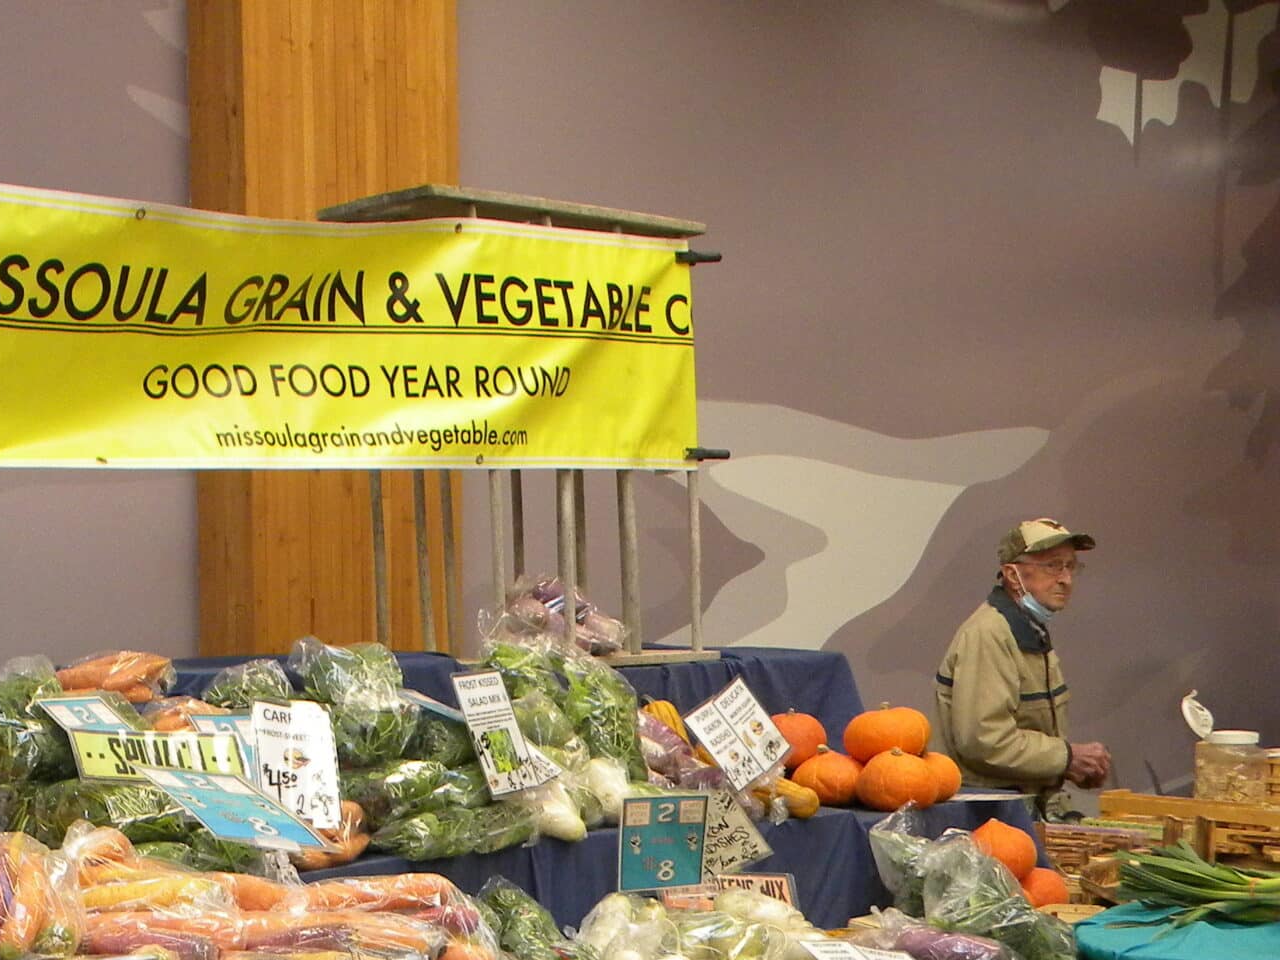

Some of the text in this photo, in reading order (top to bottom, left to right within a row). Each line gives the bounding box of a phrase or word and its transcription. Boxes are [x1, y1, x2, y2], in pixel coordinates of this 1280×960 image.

[224, 269, 366, 326] GRAIN
[386, 271, 424, 324] &
[435, 272, 652, 333] VEGETABLE
[665, 293, 694, 336] C
[143, 363, 571, 400] GOOD FOOD YEAR ROUND
[216, 419, 529, 454] missoulagrainandvegetable.com
[656, 802, 676, 823] 2
